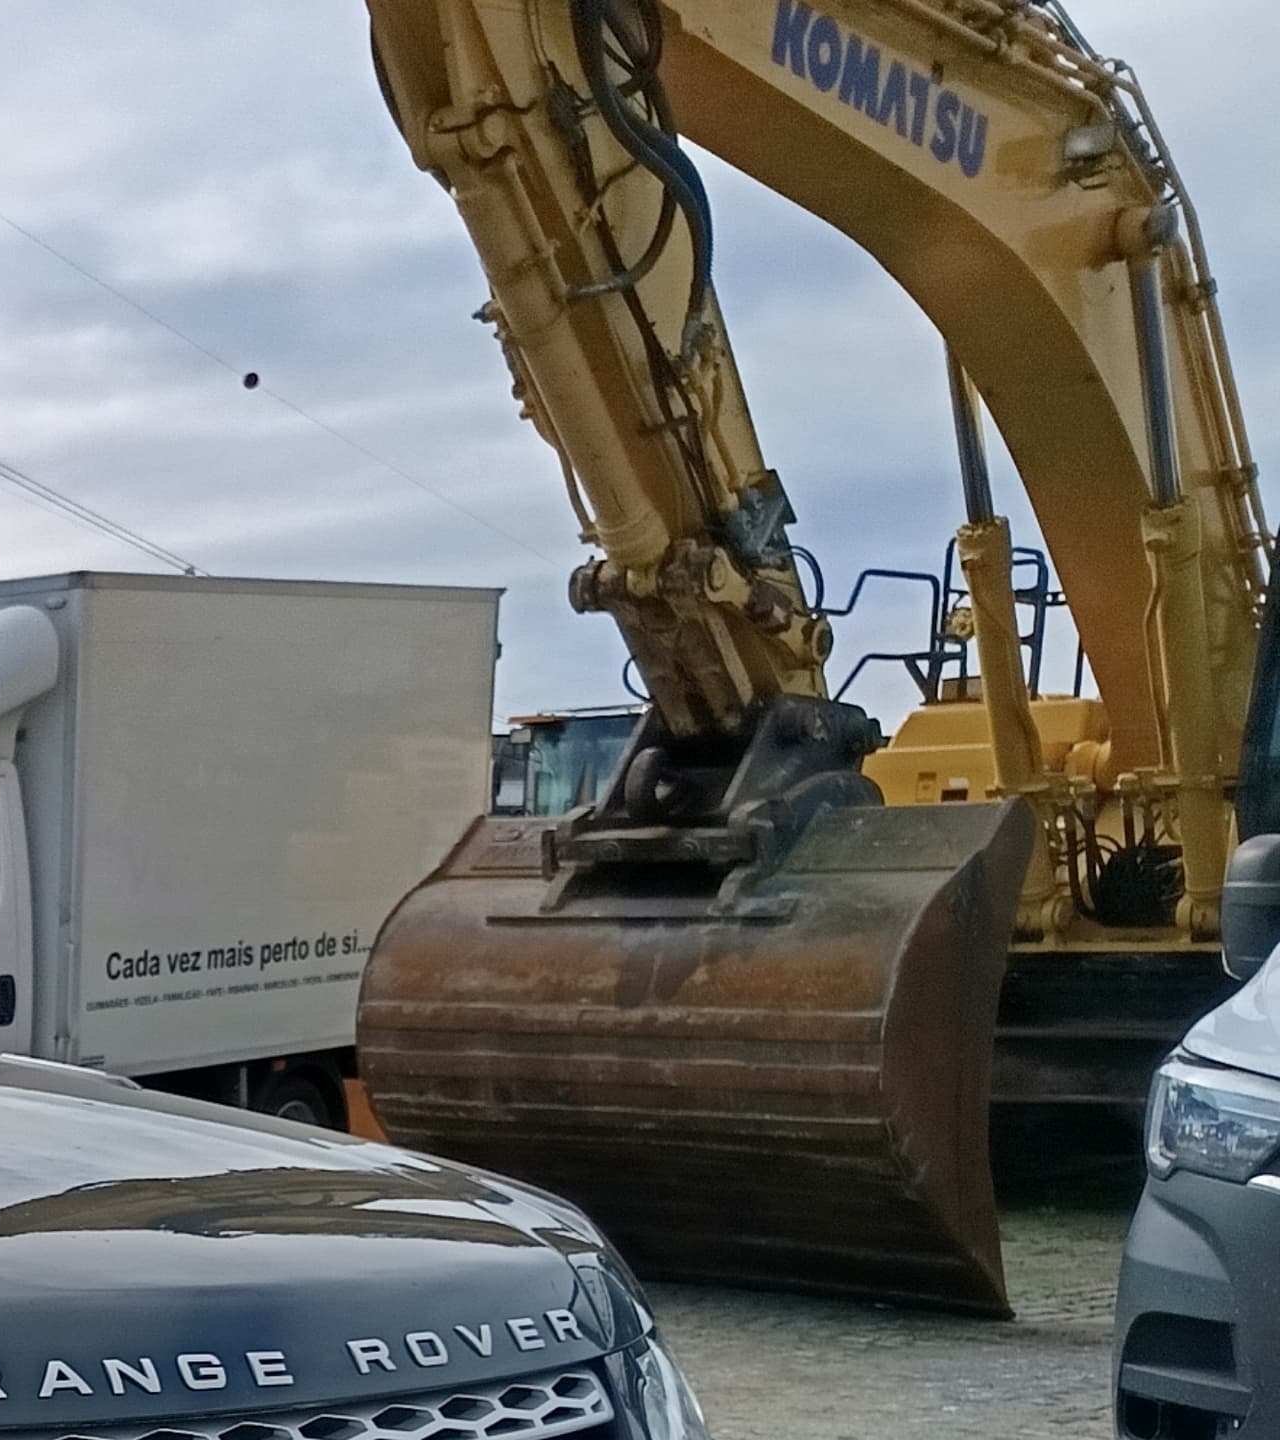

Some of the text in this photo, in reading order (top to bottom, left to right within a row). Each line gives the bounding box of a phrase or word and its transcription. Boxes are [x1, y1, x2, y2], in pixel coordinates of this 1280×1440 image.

[771, 0, 988, 178] KOMATSU
[106, 950, 161, 980] Cada
[167, 951, 202, 974] vez
[207, 940, 254, 970] mais
[260, 936, 309, 971] perto
[315, 932, 337, 958] de
[345, 1308, 584, 1375] ROVER
